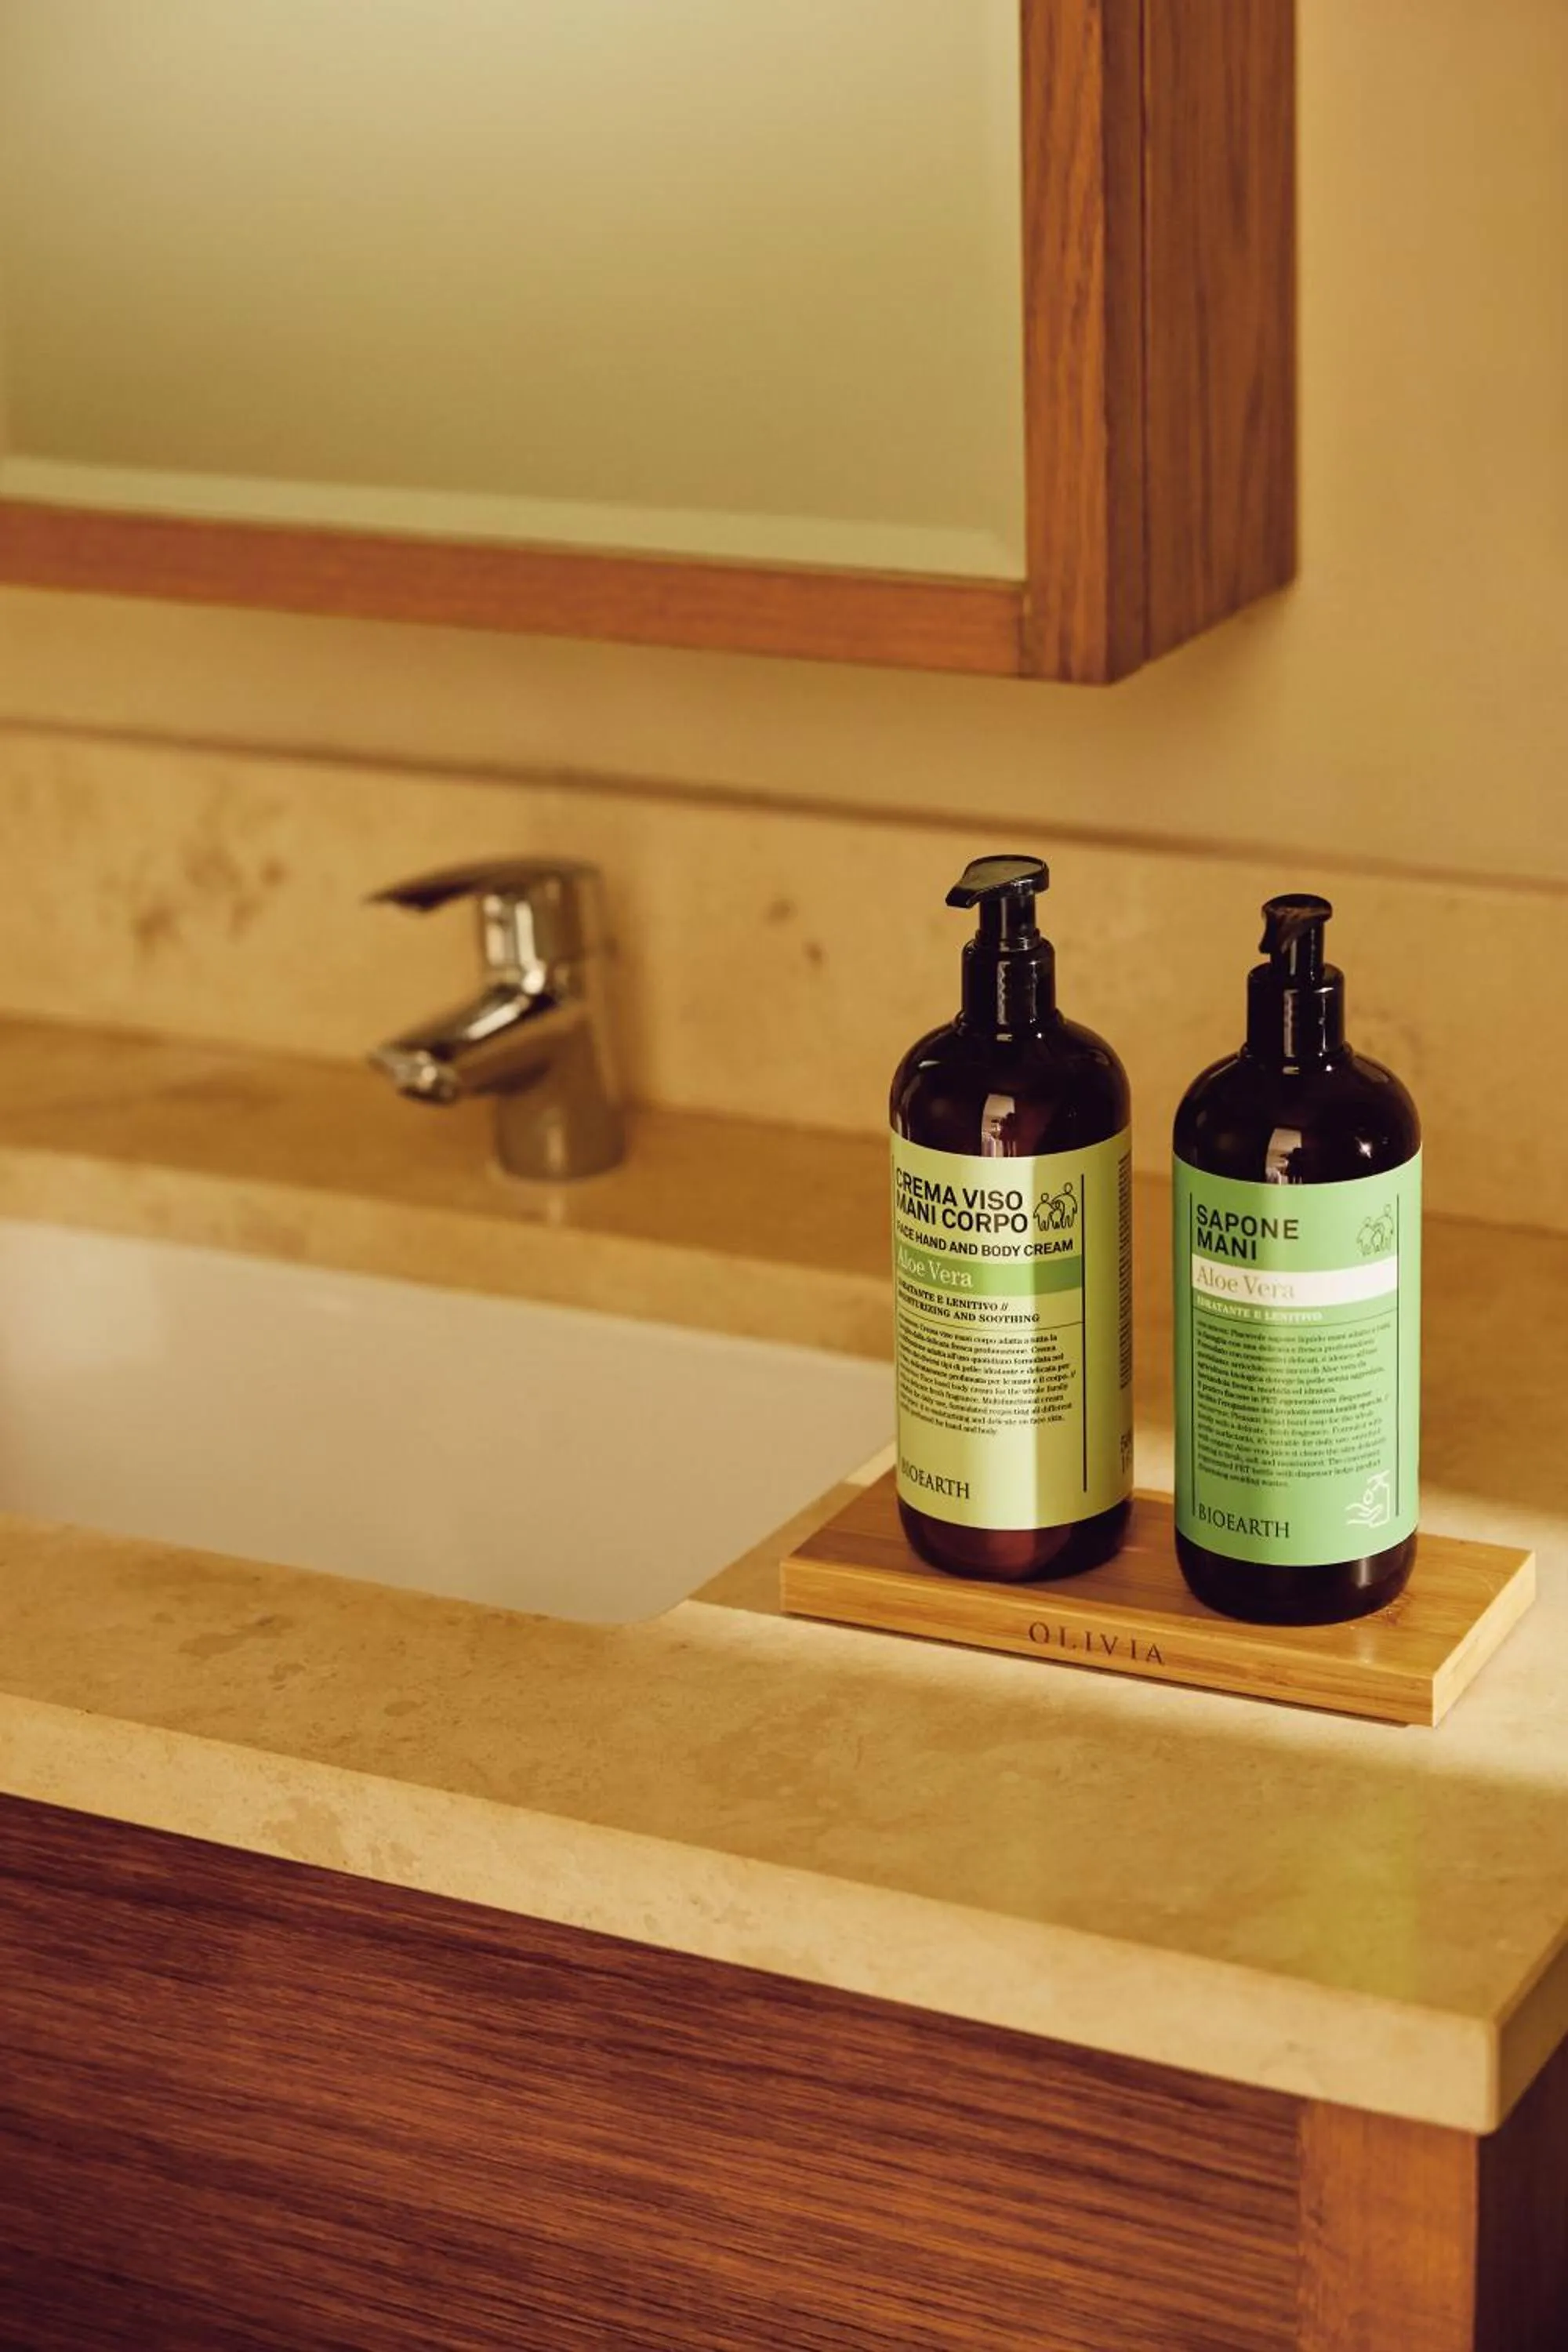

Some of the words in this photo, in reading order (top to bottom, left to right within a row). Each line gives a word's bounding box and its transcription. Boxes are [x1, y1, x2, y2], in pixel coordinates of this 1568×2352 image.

[896, 1167, 957, 1207] CREMA
[962, 1188, 1023, 1212] VISO
[896, 1189, 935, 1225] MANI
[942, 1208, 1028, 1233] CORPO
[1196, 1203, 1299, 1240] SAPONE
[915, 1231, 946, 1250] HAND
[949, 1241, 978, 1255] AND
[981, 1244, 1021, 1257] BODY
[1023, 1238, 1074, 1256] CREAM
[1196, 1227, 1257, 1261] MANI
[898, 1245, 925, 1277] Aloe
[928, 1260, 974, 1288] Vera
[1196, 1266, 1239, 1292] Aloe
[1243, 1274, 1294, 1300] Vera
[937, 1294, 944, 1304] E
[946, 1296, 998, 1311] LENITIVO
[953, 1308, 976, 1322] AND
[978, 1312, 1040, 1323] SOOTHING
[1196, 1295, 1251, 1319] IDRATANTE
[1264, 1311, 1323, 1323] LENITIVO
[902, 1457, 969, 1499] BIOEARTH
[1198, 1502, 1290, 1538] BIOEARTH
[1029, 1621, 1165, 1667] OLIVIA
